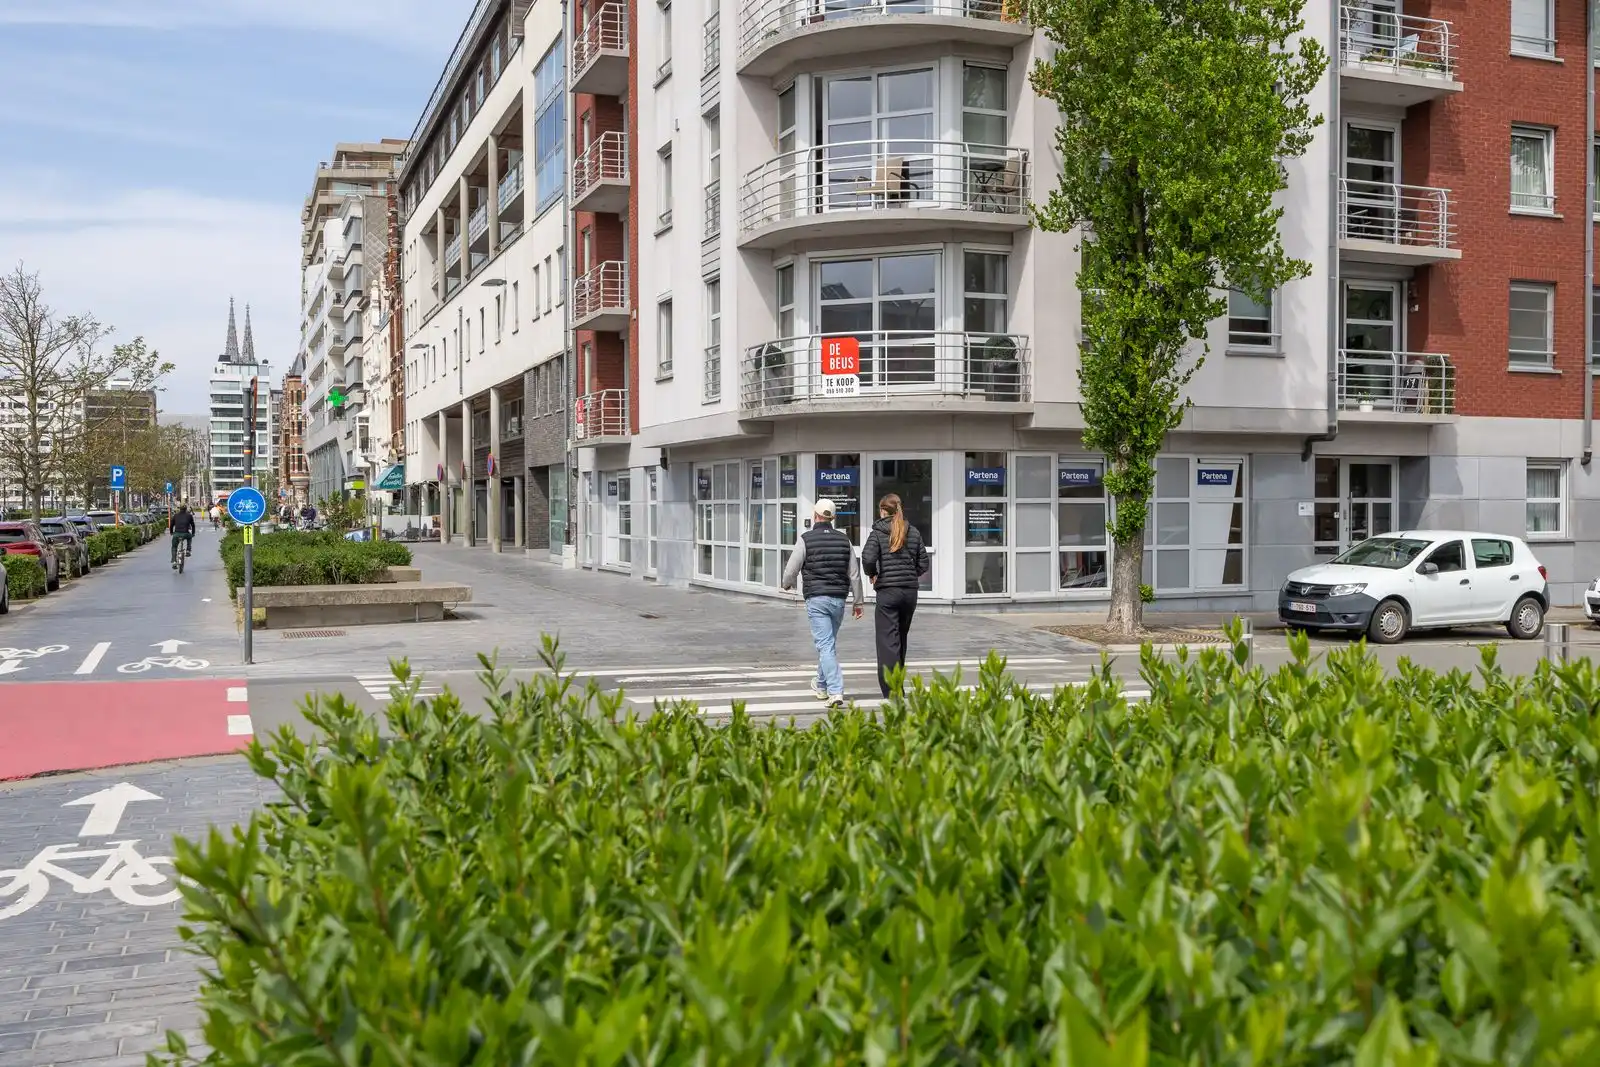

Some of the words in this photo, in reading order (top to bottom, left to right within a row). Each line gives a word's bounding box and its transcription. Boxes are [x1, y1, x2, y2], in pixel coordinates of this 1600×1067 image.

[829, 343, 841, 356] DE
[829, 357, 854, 370] BEUS
[826, 378, 834, 387] TE
[836, 378, 854, 387] KOOP
[113, 468, 122, 482] P
[820, 472, 850, 480] Partena
[969, 471, 998, 479] Partena
[1201, 472, 1228, 480] Partena
